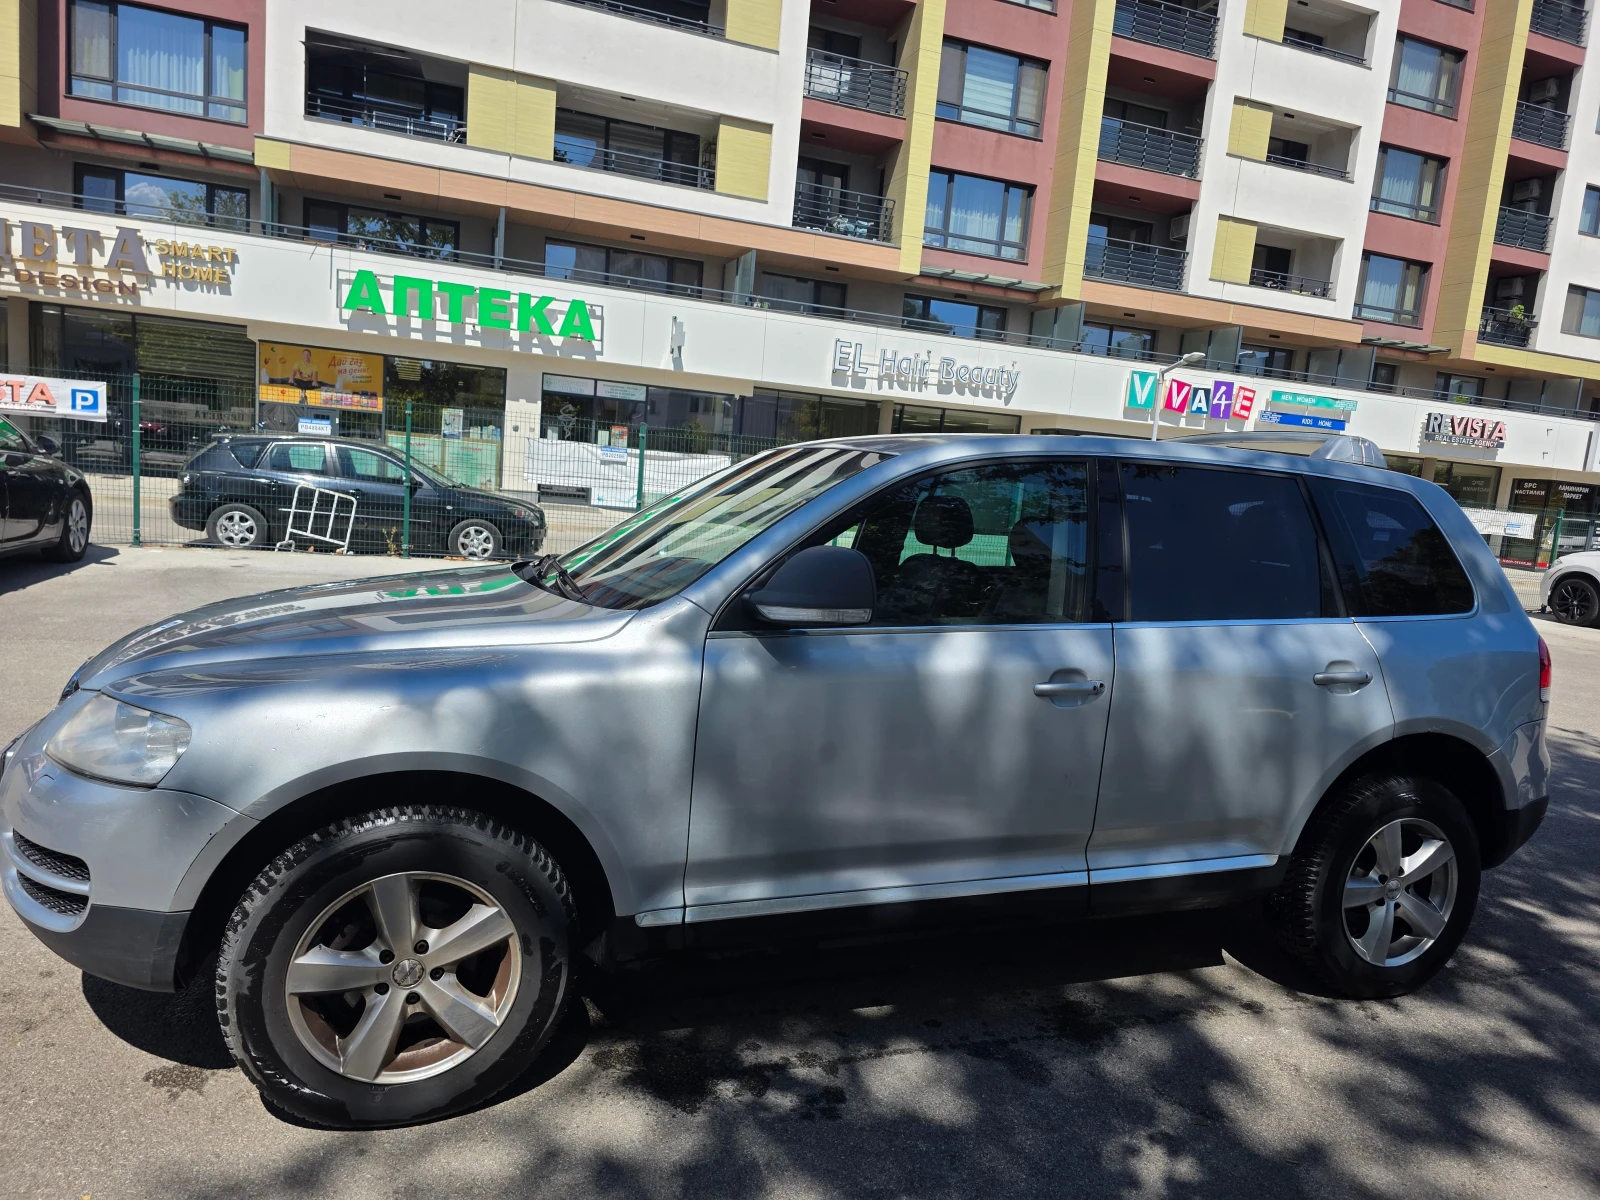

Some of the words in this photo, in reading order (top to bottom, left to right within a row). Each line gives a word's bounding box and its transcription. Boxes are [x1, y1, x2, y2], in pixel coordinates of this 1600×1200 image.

[155, 238, 236, 263] SMART
[15, 268, 137, 295] DESIGN
[162, 262, 228, 285] HOME
[343, 269, 595, 340] АПТЕКА
[834, 340, 868, 374] EL
[880, 349, 930, 377] Hair
[940, 357, 1021, 392] Beauty
[76, 391, 94, 410] P
[1132, 372, 1255, 419] VVA4E
[1296, 396, 1316, 404] WOMEN
[1318, 420, 1332, 428] HOME
[1428, 413, 1507, 441] REVISTA
[1434, 434, 1450, 442] REAL
[1451, 436, 1473, 445] ESTATE
[1473, 439, 1498, 447] AGENCY
[1562, 492, 1582, 500] ПАРКЕТ
